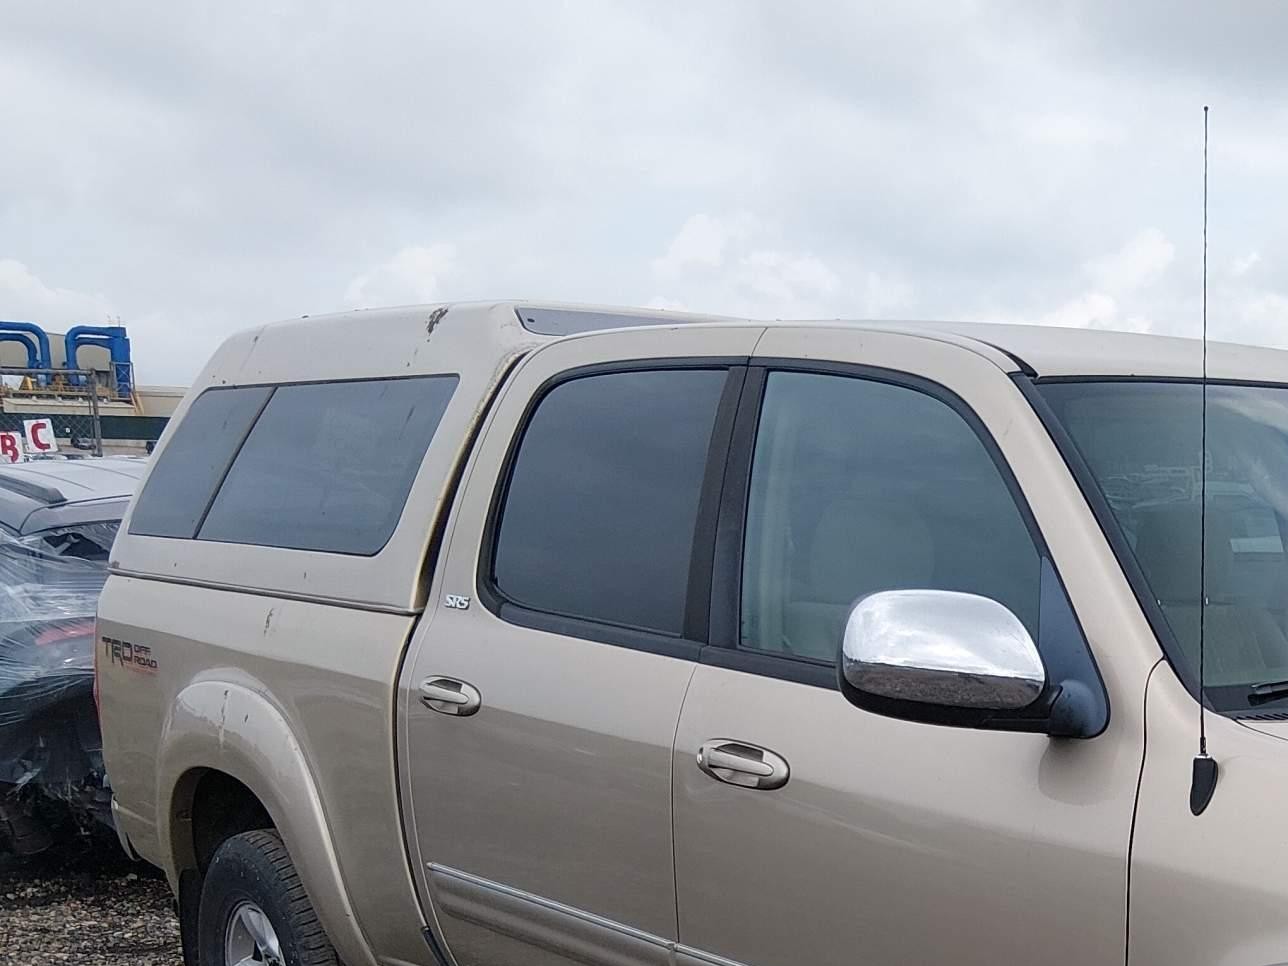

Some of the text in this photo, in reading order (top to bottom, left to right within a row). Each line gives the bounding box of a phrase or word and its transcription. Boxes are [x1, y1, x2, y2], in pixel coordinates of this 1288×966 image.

[0, 434, 19, 463] B
[31, 422, 51, 451] C
[445, 594, 470, 610] SR5
[101, 636, 151, 668] TRD OFF
[134, 655, 158, 669] ROAD
